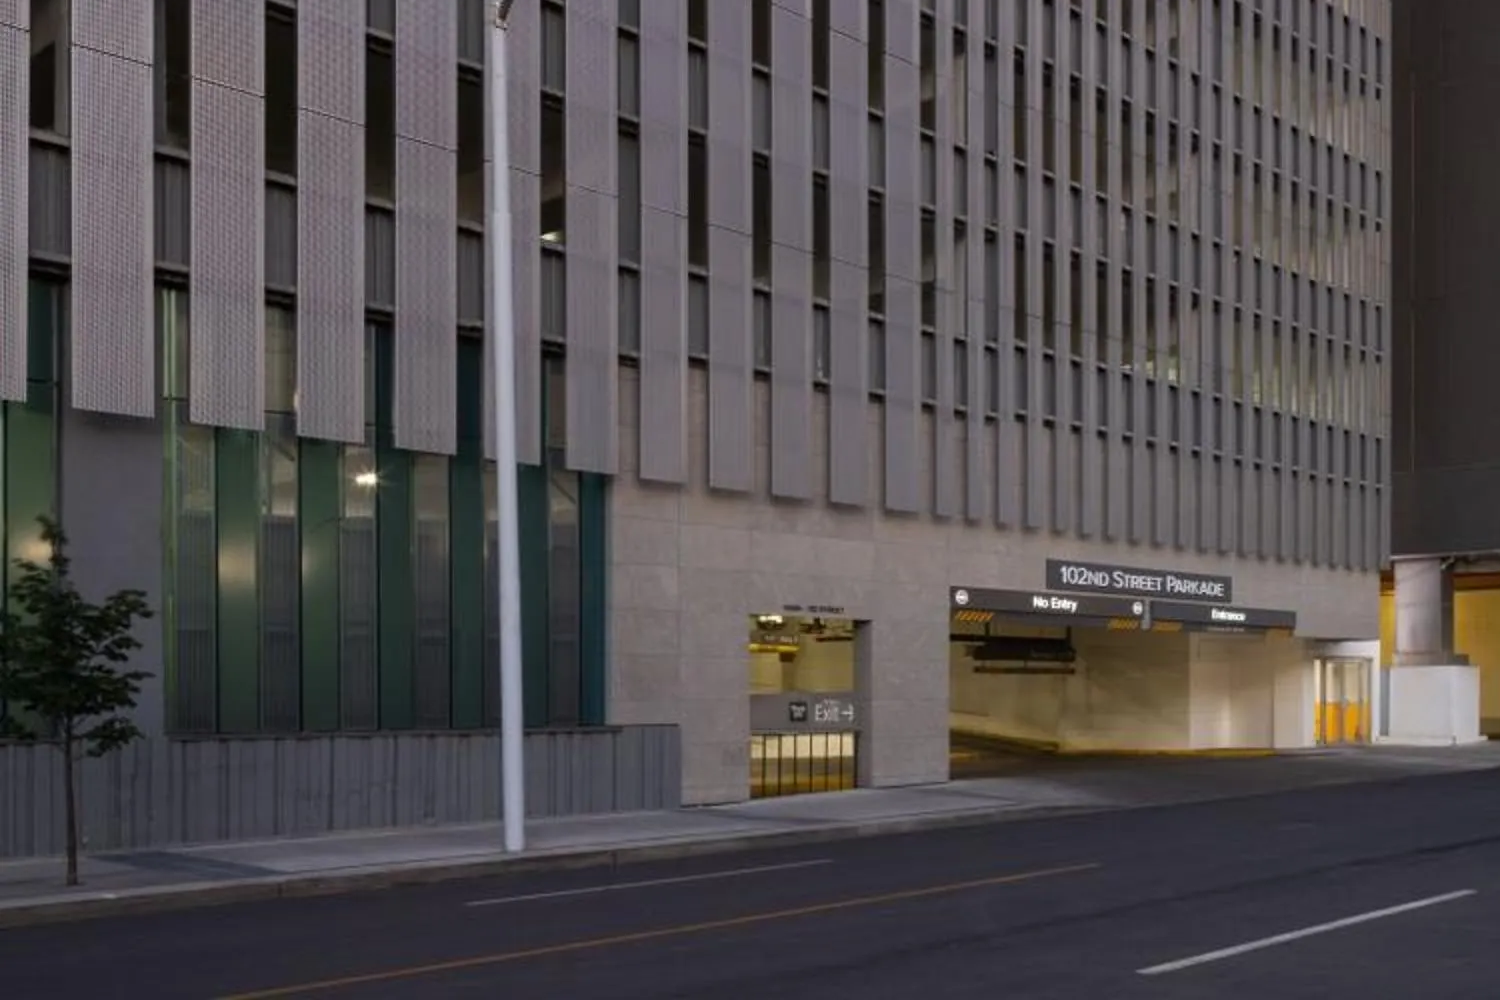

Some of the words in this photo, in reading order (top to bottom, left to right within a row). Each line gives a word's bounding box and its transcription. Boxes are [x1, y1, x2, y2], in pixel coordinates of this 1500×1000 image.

[1060, 565, 1109, 587] 102ND
[1112, 571, 1163, 592] STREET
[1166, 575, 1224, 597] PARKADE
[1033, 596, 1049, 608] No
[1051, 597, 1078, 613] Entry
[815, 703, 839, 721] Exit
